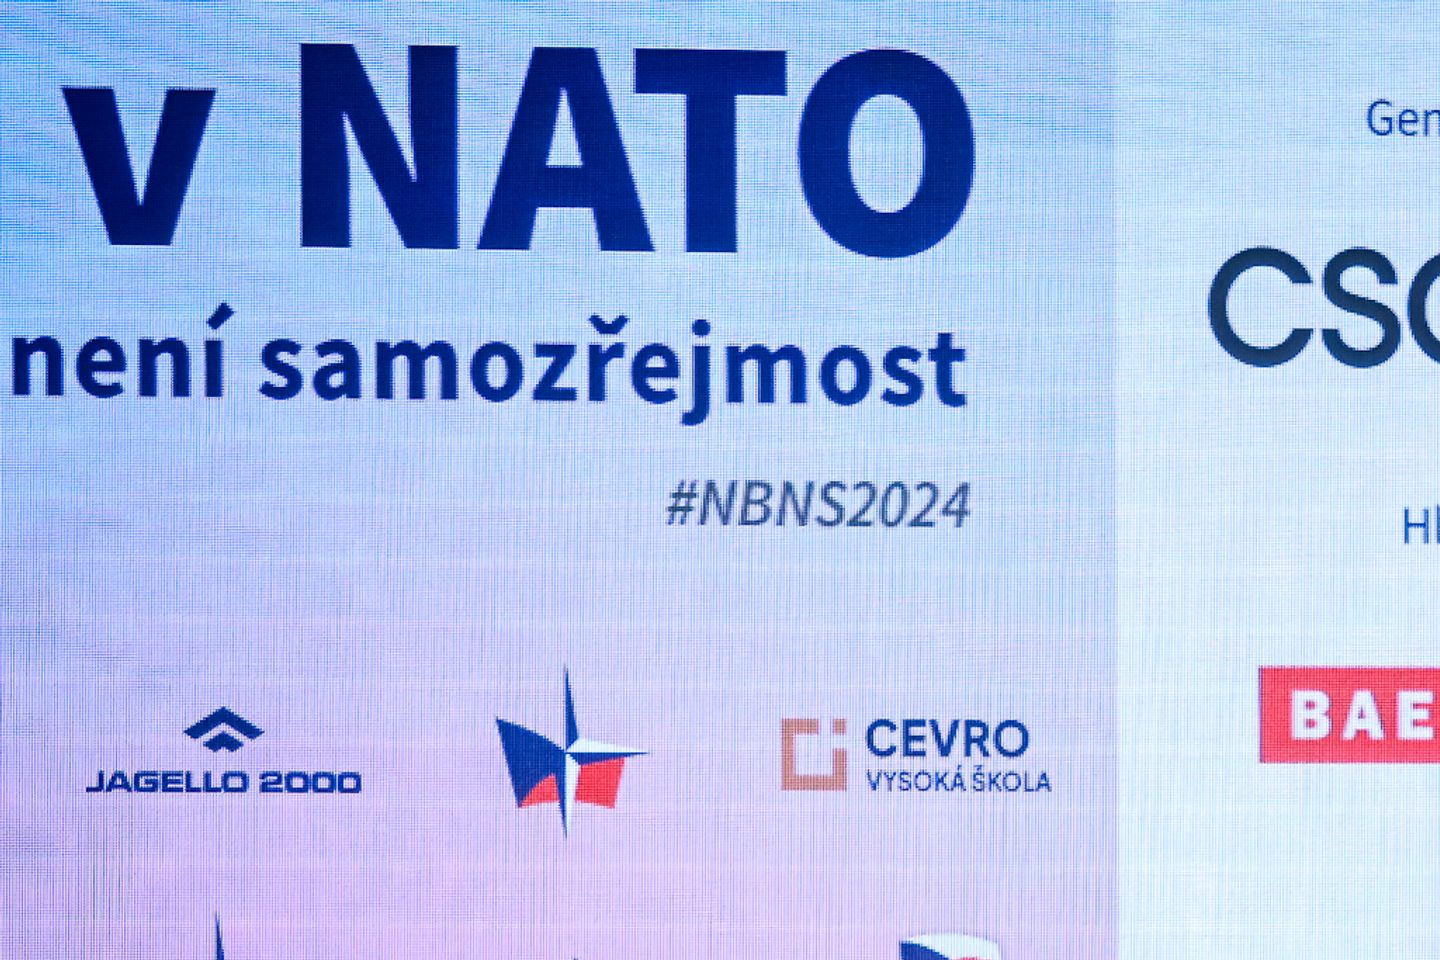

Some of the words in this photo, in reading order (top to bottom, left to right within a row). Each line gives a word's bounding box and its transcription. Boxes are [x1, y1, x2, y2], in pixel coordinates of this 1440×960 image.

[61, 86, 216, 246] v
[300, 43, 975, 258] NATO
[11, 302, 235, 399] není
[259, 314, 967, 426] samozřejmost
[667, 480, 971, 528] #NBNS2024
[865, 718, 1030, 758] CEVRO
[1290, 690, 1434, 740] BAE
[85, 770, 250, 793] JAGELLO
[259, 770, 362, 794] 2000
[866, 765, 966, 792] VYSOKÁ
[972, 765, 1052, 793] ŠKOLA
